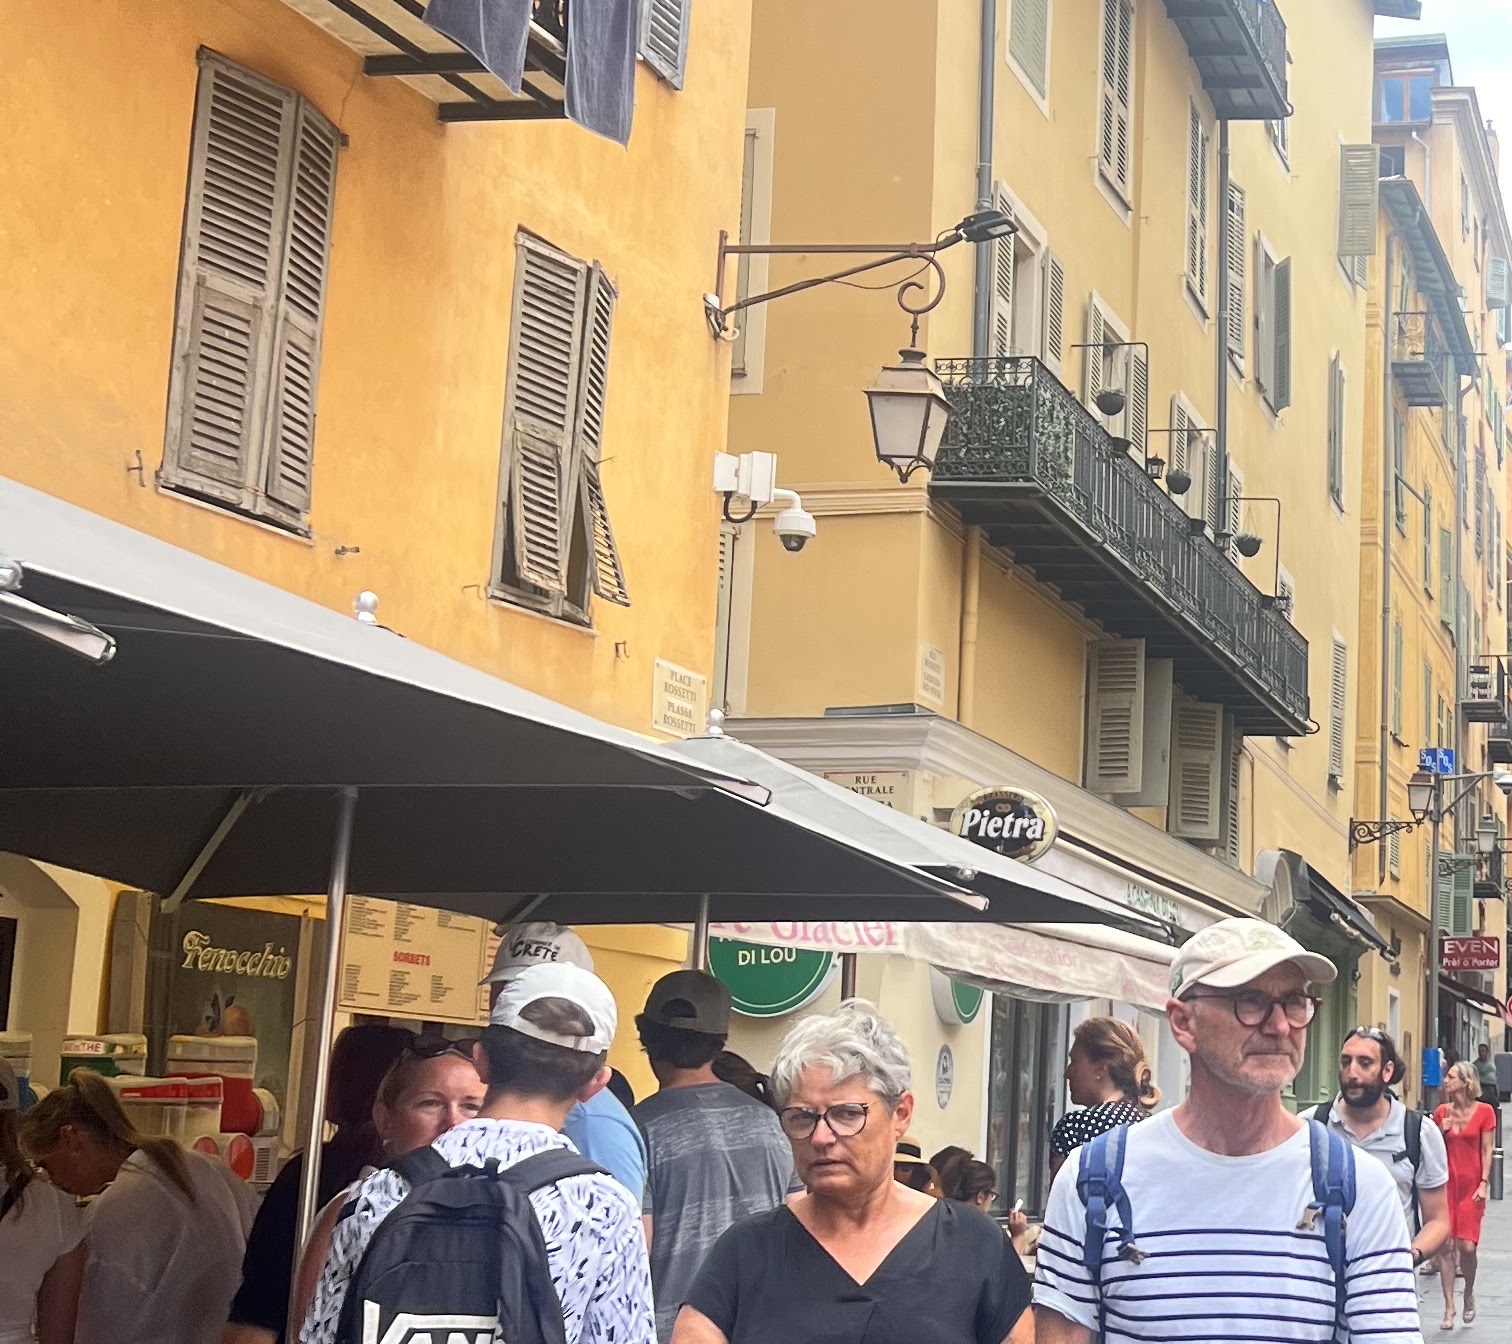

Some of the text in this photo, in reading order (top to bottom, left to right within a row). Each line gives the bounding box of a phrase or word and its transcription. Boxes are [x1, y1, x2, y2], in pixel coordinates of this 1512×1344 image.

[670, 670, 692, 688] PLACE
[664, 681, 697, 702] ROSSETTI
[663, 714, 696, 734] ROSSETTI
[854, 776, 877, 784] RUE
[960, 808, 1044, 840] Pietra
[182, 930, 292, 980] Fenocchio
[511, 940, 558, 962] CRETE
[738, 946, 797, 966] DI LOU
[1444, 940, 1499, 954] EVEN
[1472, 958, 1498, 966] Porter
